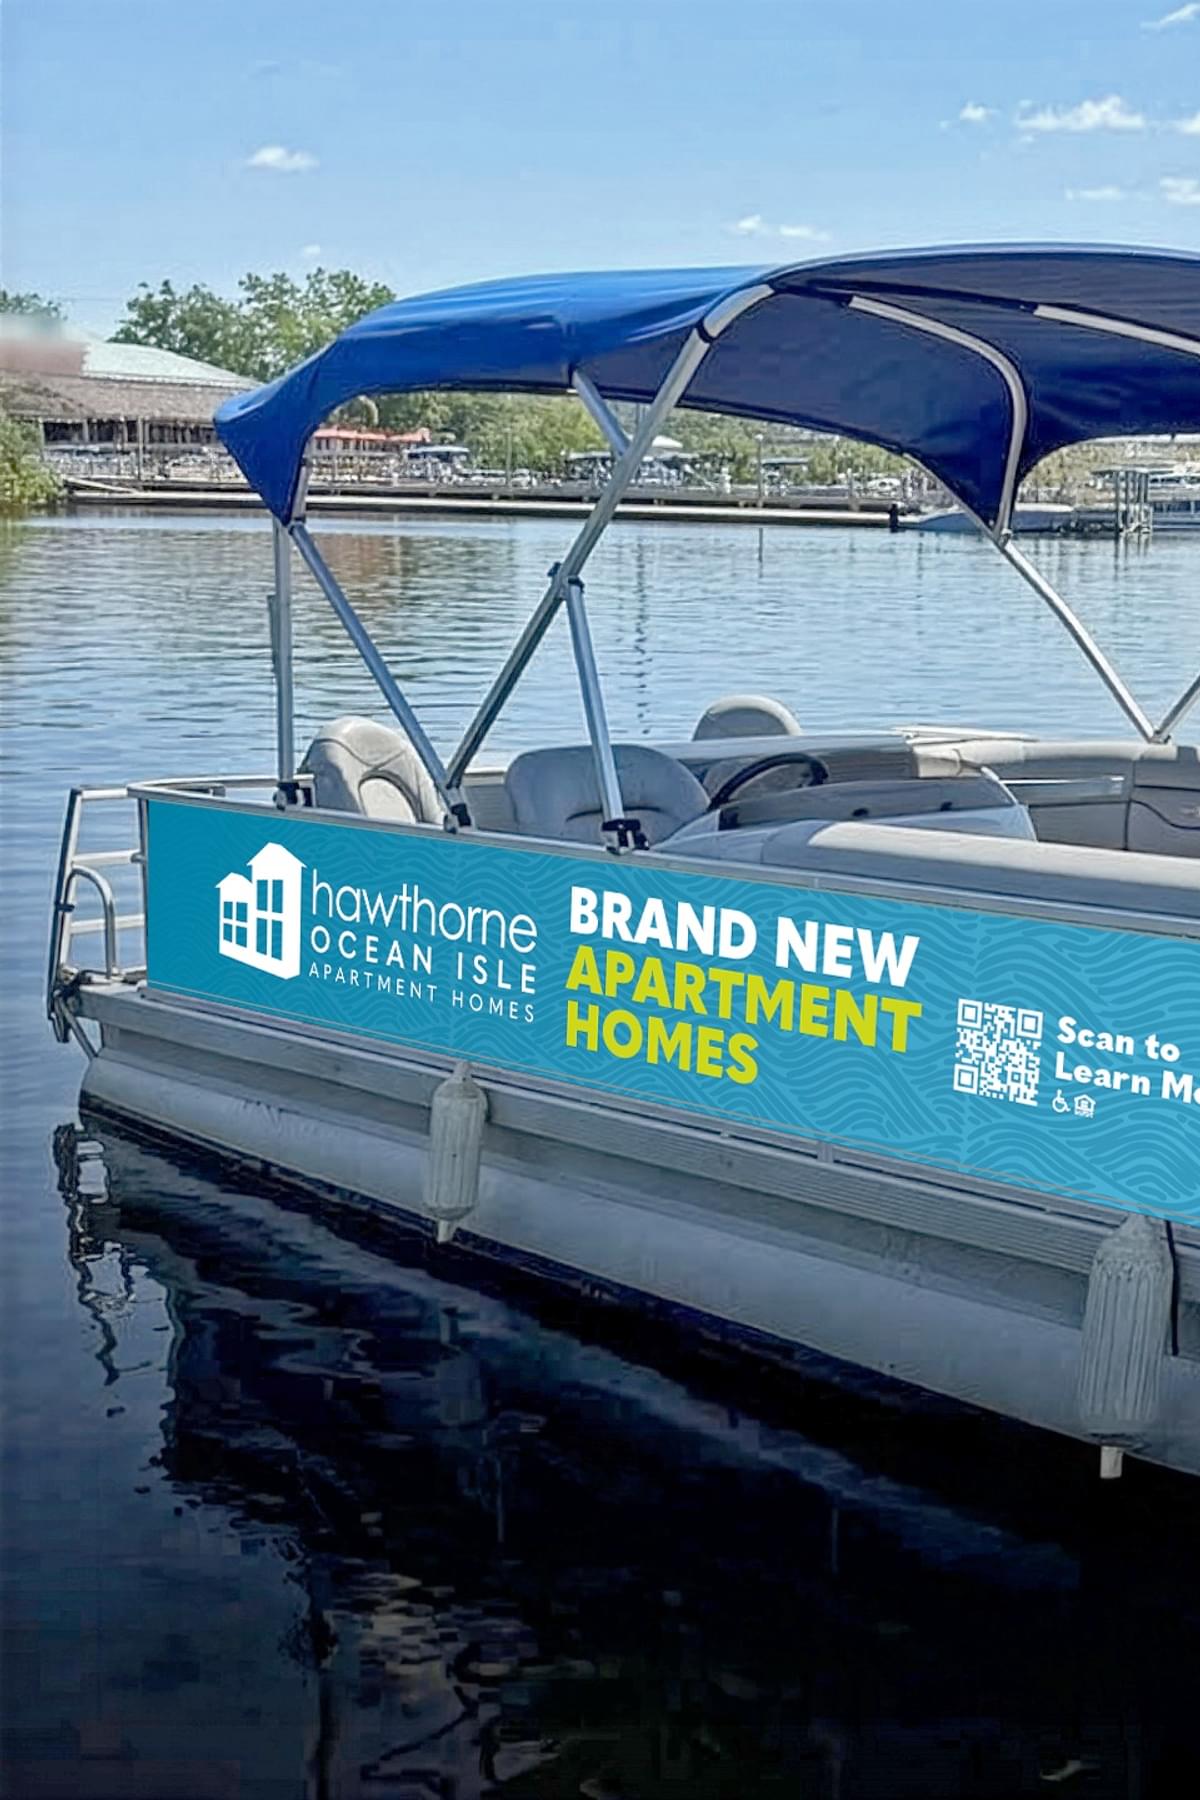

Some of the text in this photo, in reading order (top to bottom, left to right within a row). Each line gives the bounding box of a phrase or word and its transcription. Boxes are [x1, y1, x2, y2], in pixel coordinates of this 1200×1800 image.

[312, 868, 538, 953] hawthorne
[569, 885, 921, 988] BRAND NEW
[309, 962, 535, 1023] APARTMENT HOMES
[310, 925, 536, 994] OCEAN ISLE
[565, 944, 923, 1053] APARTMENT
[565, 1000, 759, 1086] HOMES
[1054, 1051, 1151, 1096] Learn
[1056, 1015, 1181, 1063] Scan to
